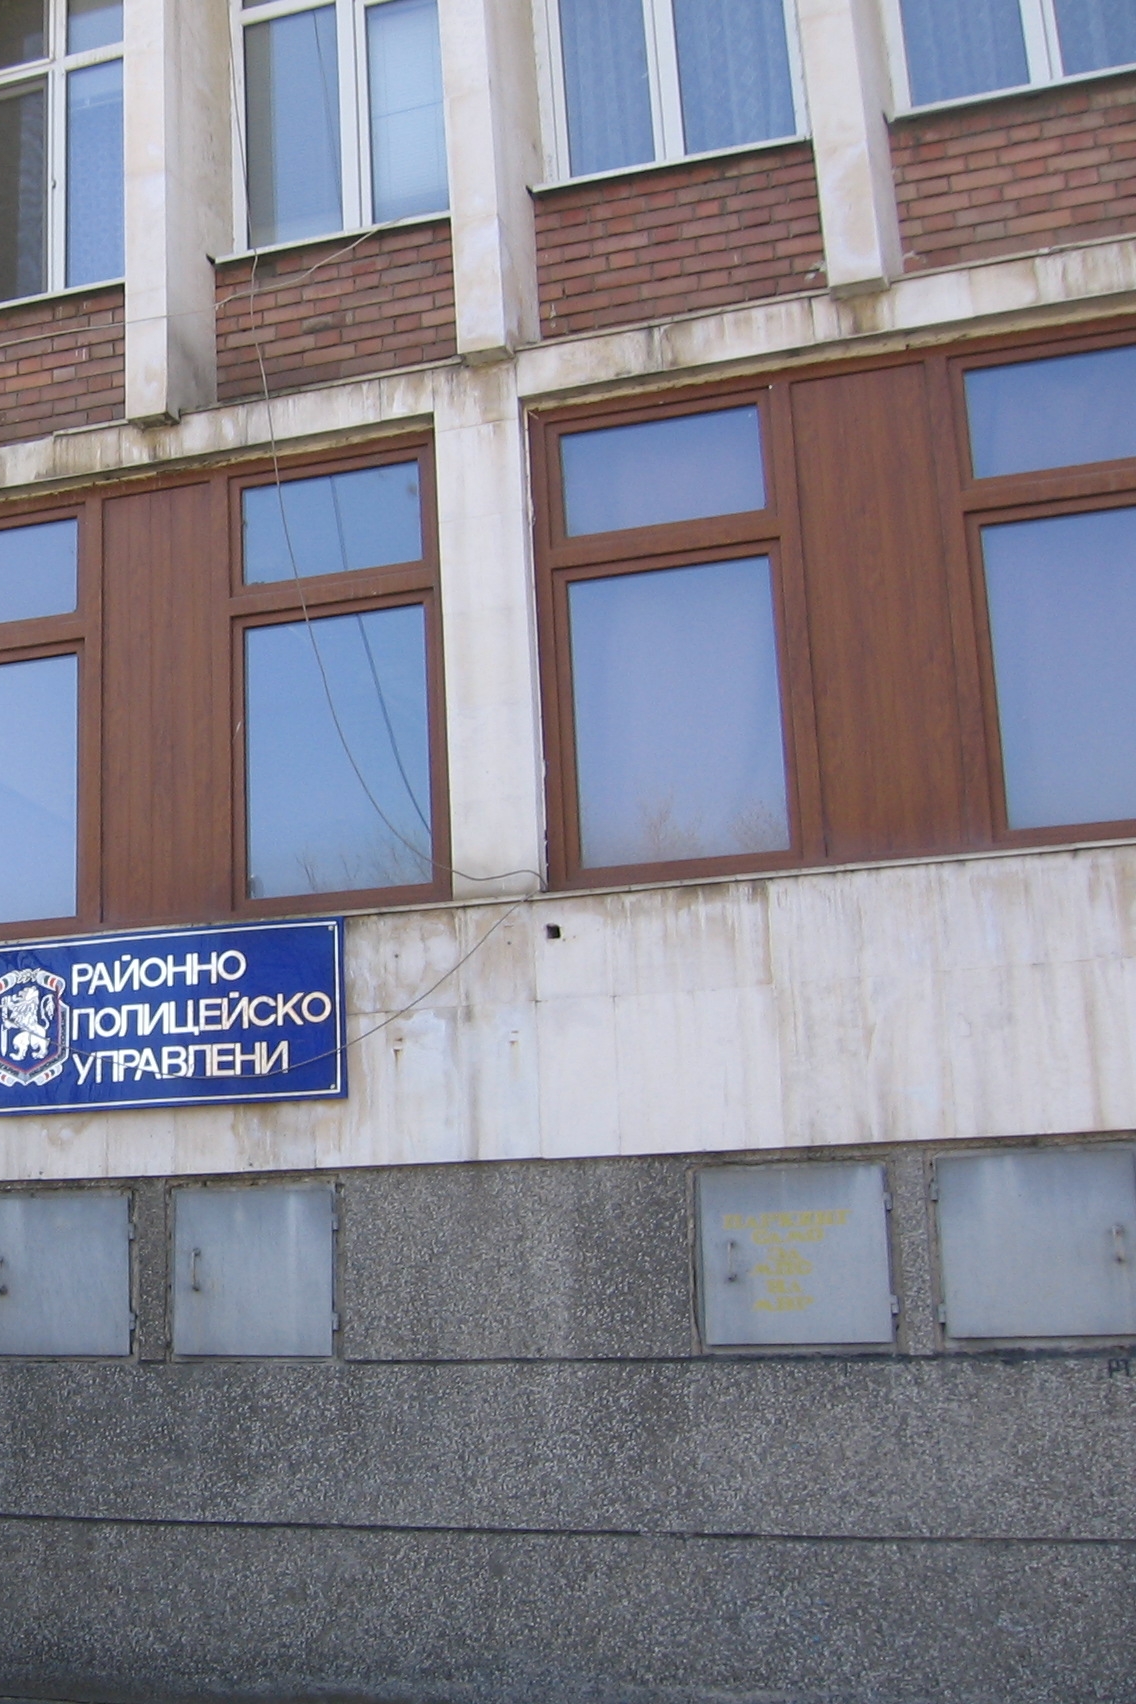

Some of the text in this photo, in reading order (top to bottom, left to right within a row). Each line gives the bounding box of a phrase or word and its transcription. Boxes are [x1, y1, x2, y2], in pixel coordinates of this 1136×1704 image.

[72, 950, 247, 996] РАЙОННО
[72, 991, 332, 1040] ПОЛИЦЕЙСКО
[72, 1041, 289, 1085] УПРАВЛЕНИ
